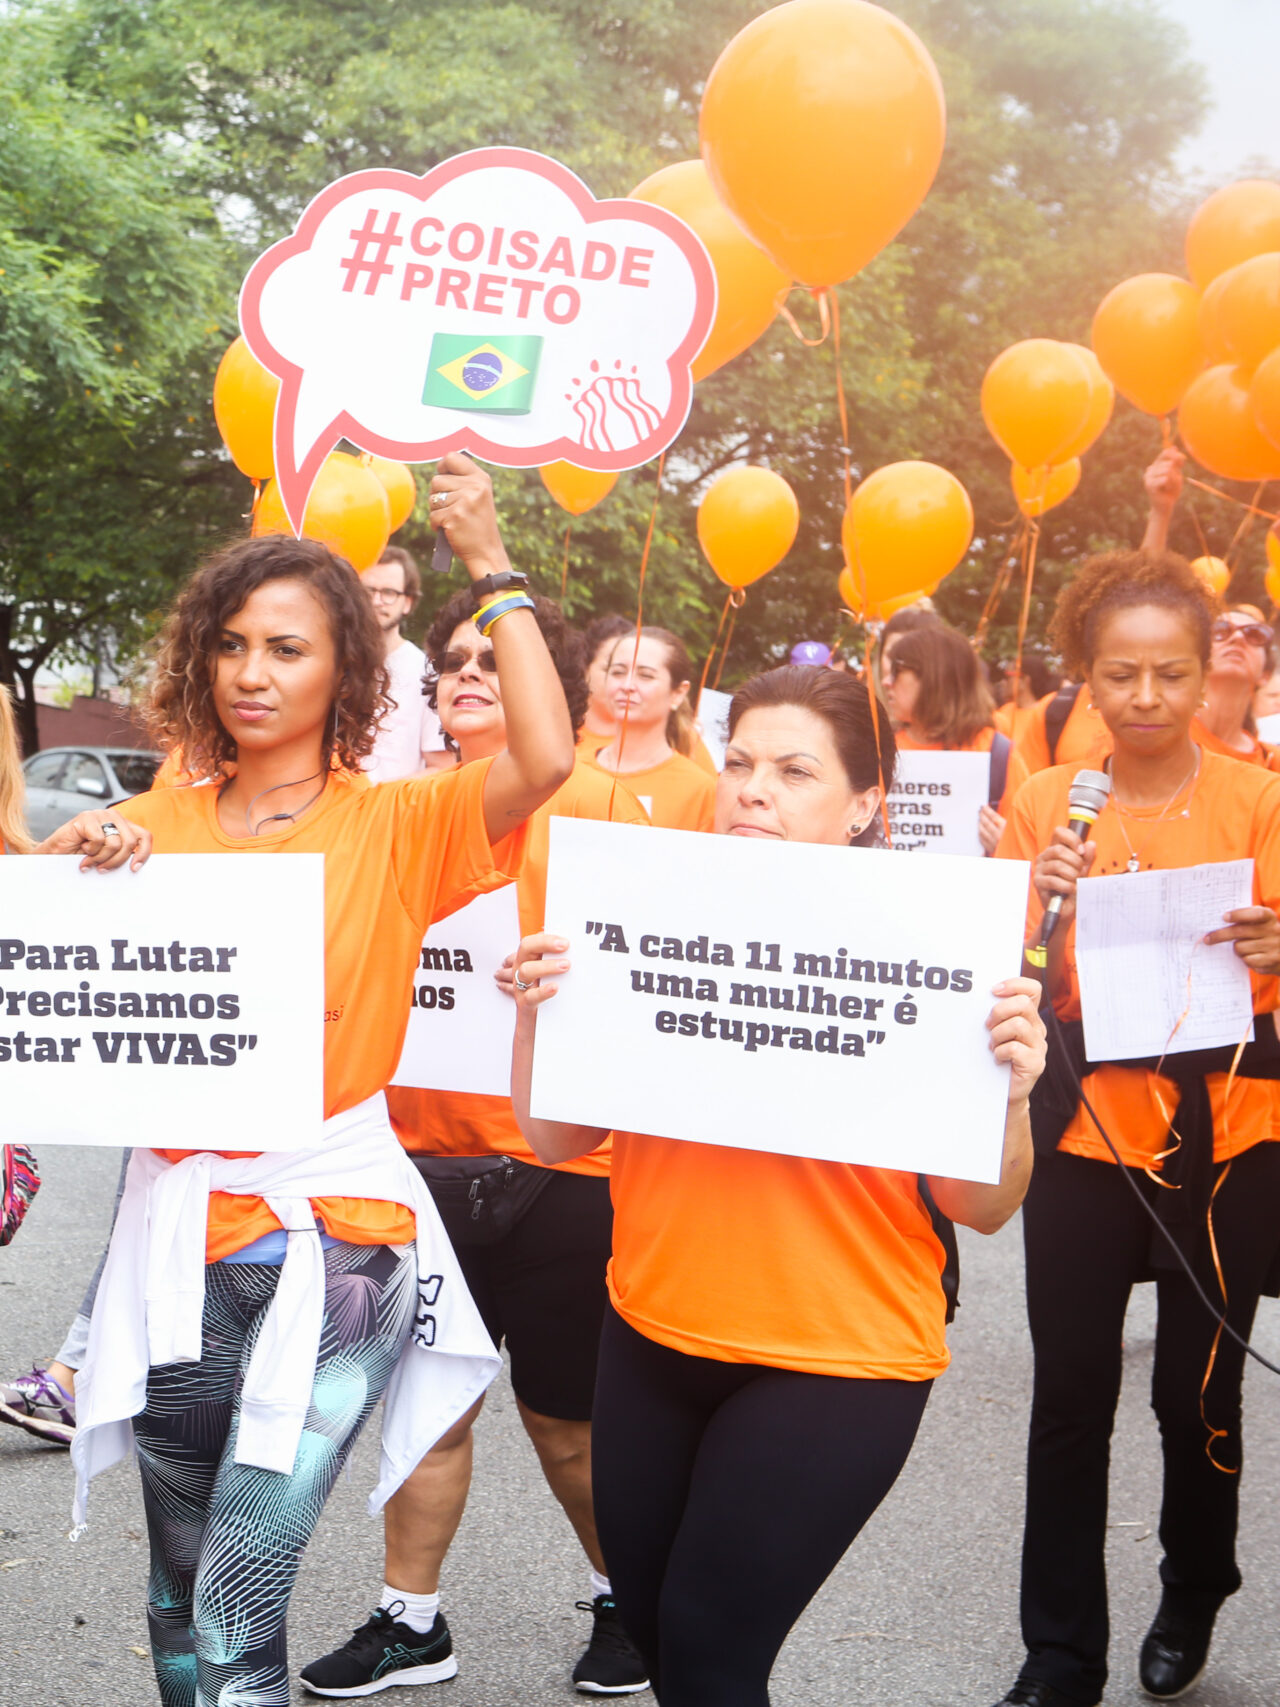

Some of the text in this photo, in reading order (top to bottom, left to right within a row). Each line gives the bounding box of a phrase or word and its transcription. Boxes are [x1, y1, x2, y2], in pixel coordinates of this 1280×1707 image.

[400, 262, 581, 325] PRETO
[111, 939, 238, 972] Lutar
[415, 946, 474, 973] ma
[585, 920, 973, 993] "A cada 11 minutos
[630, 969, 918, 1026] uma mulher é
[92, 1031, 258, 1066] VIVAS"
[655, 1009, 886, 1058] estuprada"
